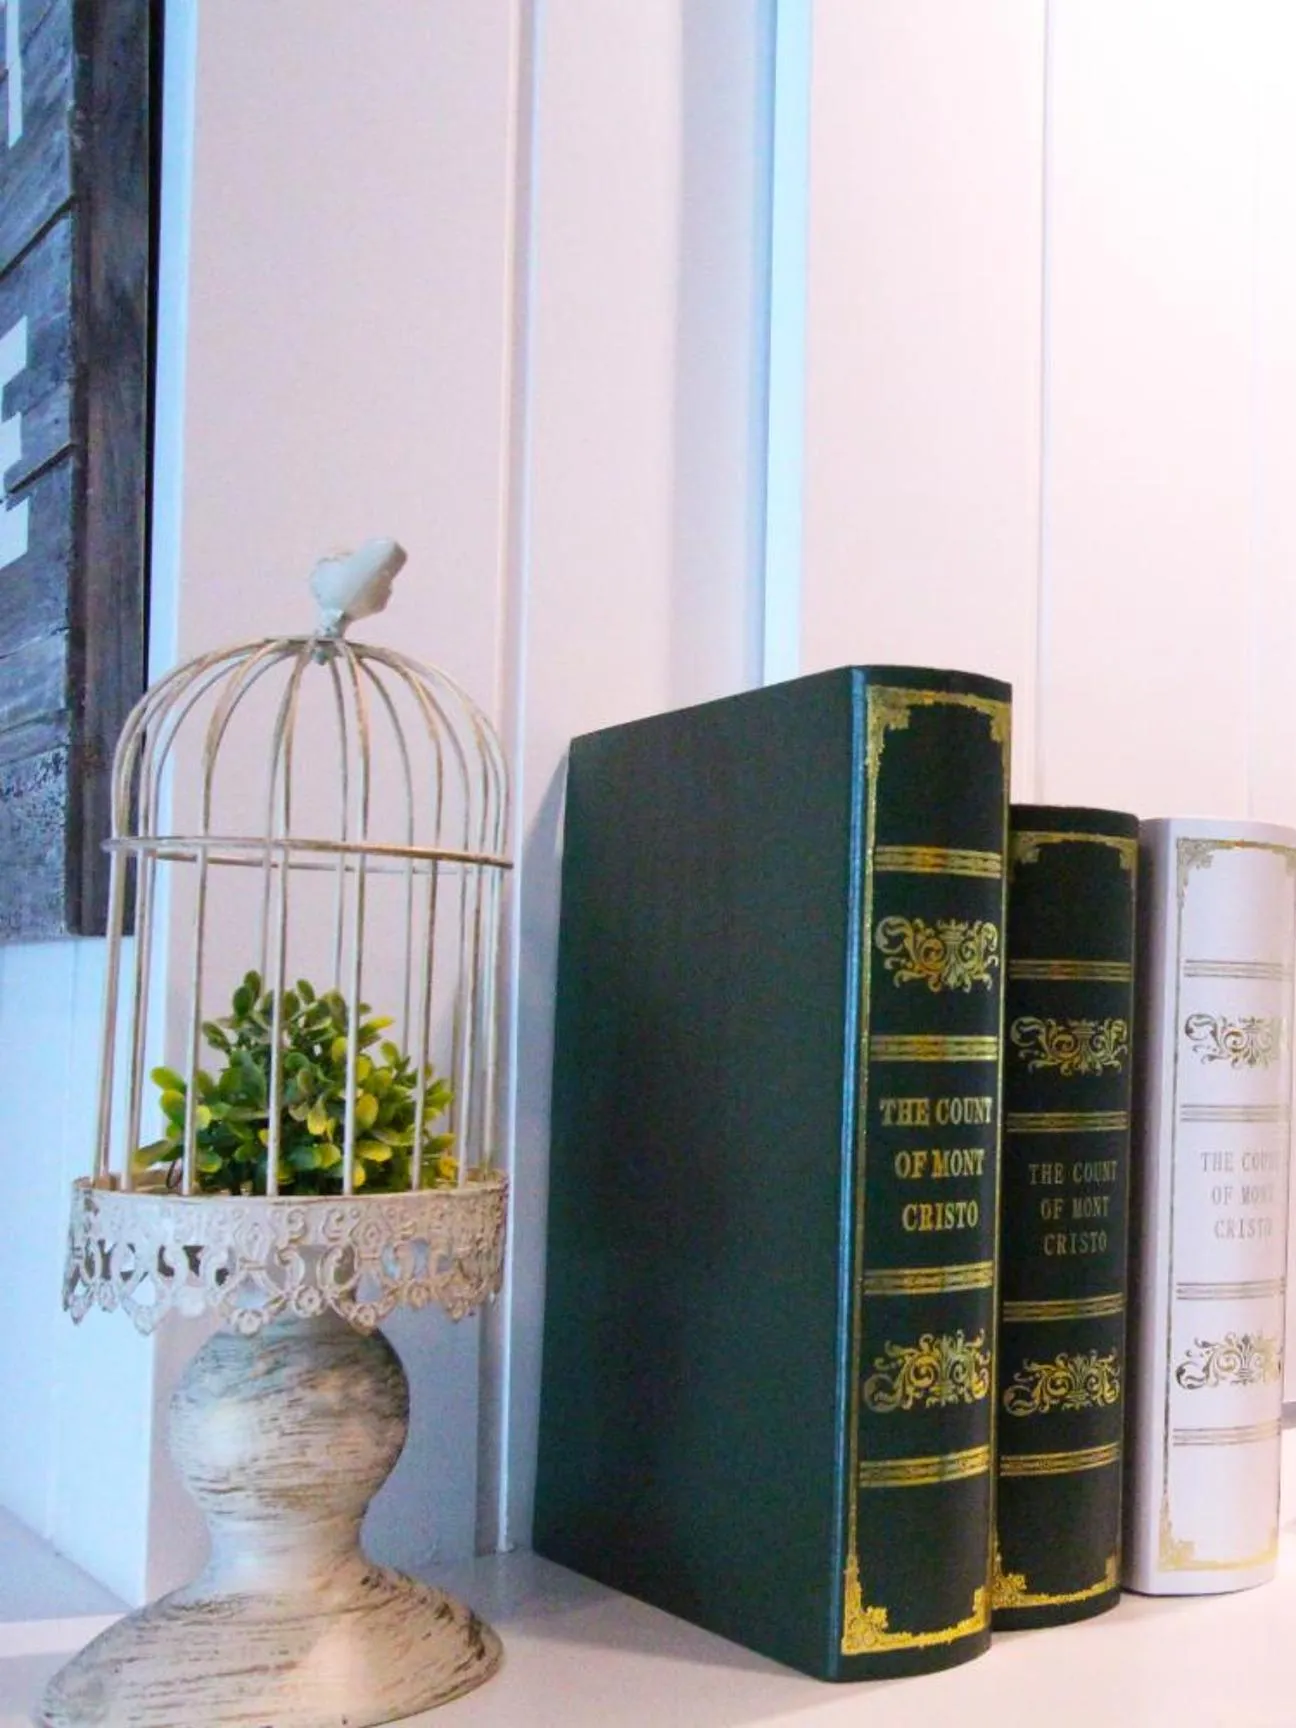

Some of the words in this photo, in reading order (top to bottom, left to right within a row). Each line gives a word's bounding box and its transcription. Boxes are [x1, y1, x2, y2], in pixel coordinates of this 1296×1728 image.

[879, 1097, 930, 1127] THE
[935, 1096, 993, 1125] COUNT
[894, 1149, 928, 1179] OF
[931, 1148, 985, 1178] MONT
[1028, 1162, 1065, 1185] THE
[1072, 1160, 1118, 1184] COUNT
[1200, 1151, 1234, 1172] THE
[1040, 1198, 1064, 1220] OF
[1071, 1195, 1110, 1219] MONT
[1211, 1185, 1234, 1206] OF
[901, 1200, 979, 1232] CRISTO
[1213, 1217, 1273, 1240] CRISTO
[1043, 1230, 1108, 1256] CRISTO
